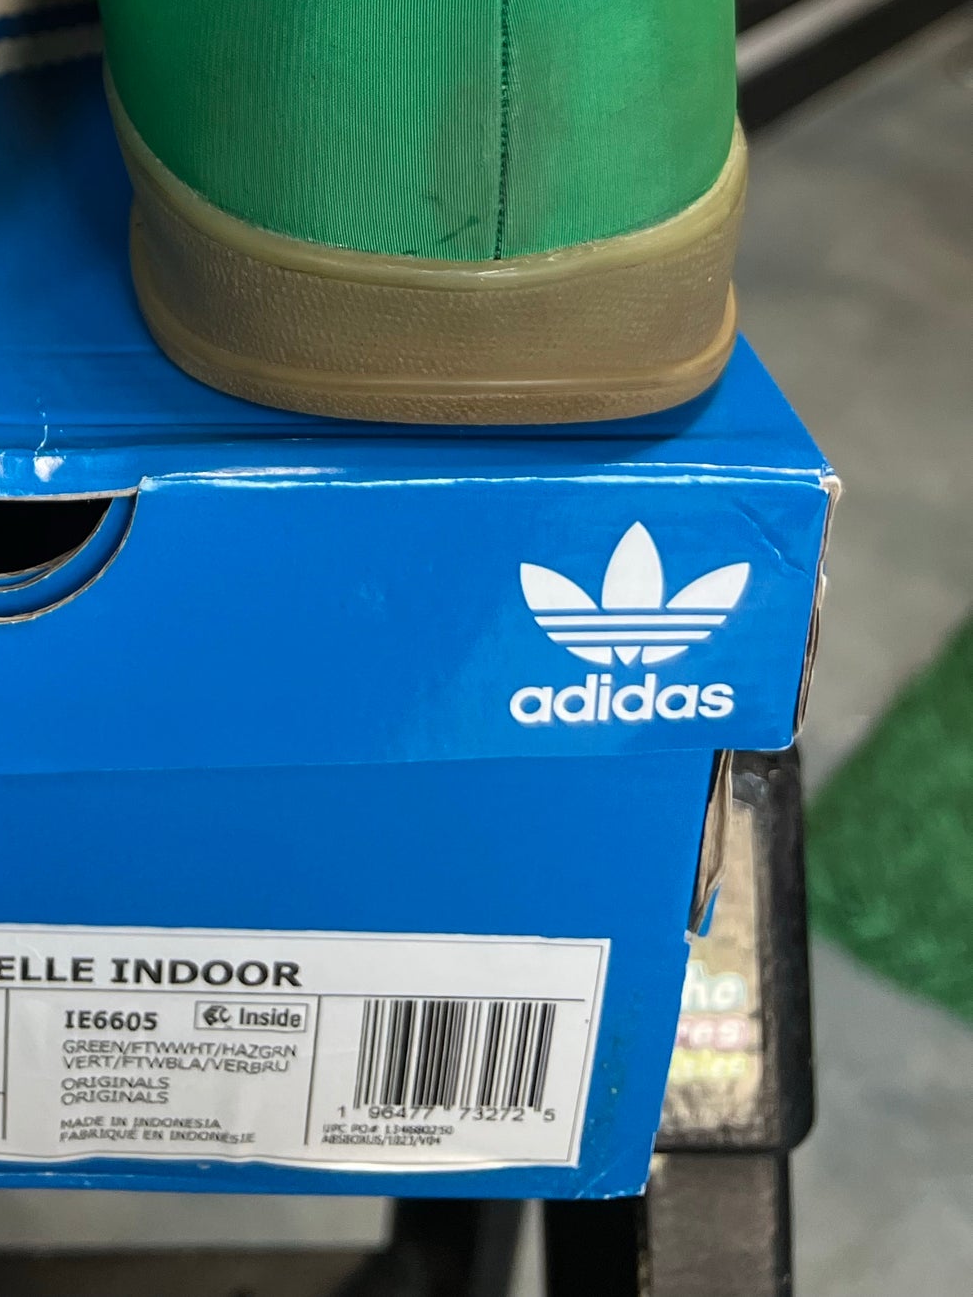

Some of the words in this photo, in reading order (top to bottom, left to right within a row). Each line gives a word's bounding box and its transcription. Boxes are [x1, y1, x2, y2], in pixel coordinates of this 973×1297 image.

[509, 673, 734, 724] adidas
[110, 958, 302, 987] INDOOR
[65, 1010, 158, 1030] IE6605
[239, 1007, 301, 1027] Inside
[63, 1040, 297, 1058] GREEN/FTWWHT/HAZGRN
[63, 1056, 289, 1073] VERT/FTWBLA/VERBRU
[61, 1077, 170, 1090] ORIGINALS
[61, 1090, 169, 1105] ORIGINALS
[338, 1106, 346, 1118] 1
[369, 1107, 435, 1119] 96477
[459, 1107, 525, 1122] 73272
[544, 1109, 555, 1122] 5
[61, 1117, 103, 1129] MADE
[111, 1117, 126, 1127] IN
[133, 1117, 221, 1129] INDONESIA
[60, 1128, 136, 1142] FABRIQUE
[143, 1130, 163, 1141] EN
[170, 1130, 255, 1143] INDONESIE
